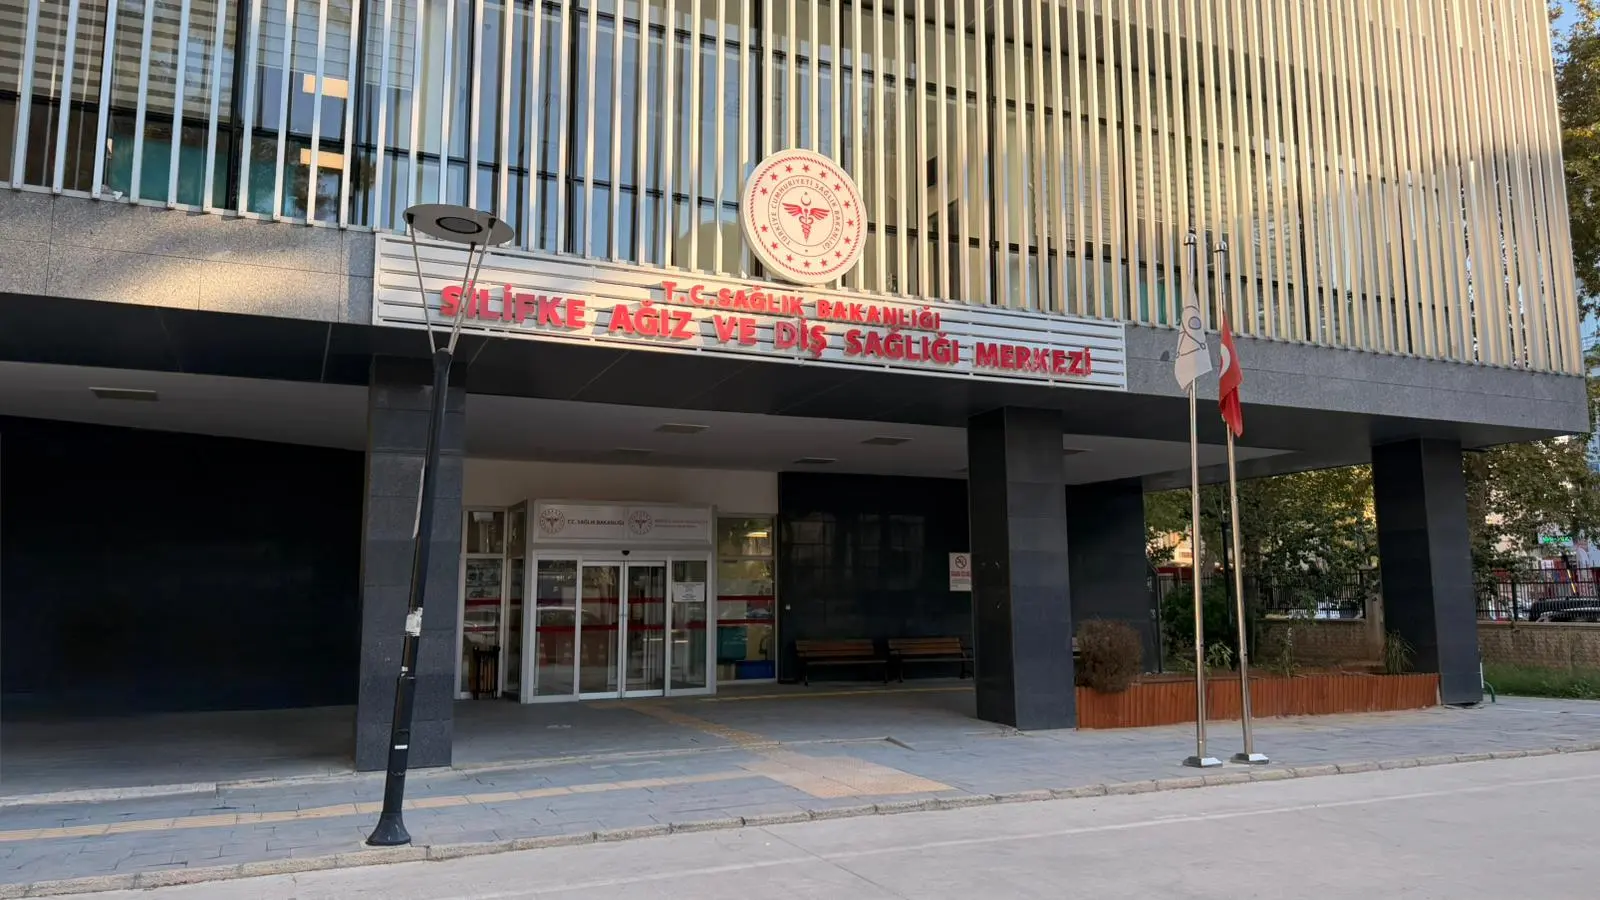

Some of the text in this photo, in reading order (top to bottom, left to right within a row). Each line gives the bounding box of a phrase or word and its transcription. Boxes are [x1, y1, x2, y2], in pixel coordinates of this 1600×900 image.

[440, 279, 1092, 377] SİLİFKE AĞIZ VE DİŞ SAĞLIĞI MERKEZİ
[817, 299, 941, 330] BAKANLIĞI
